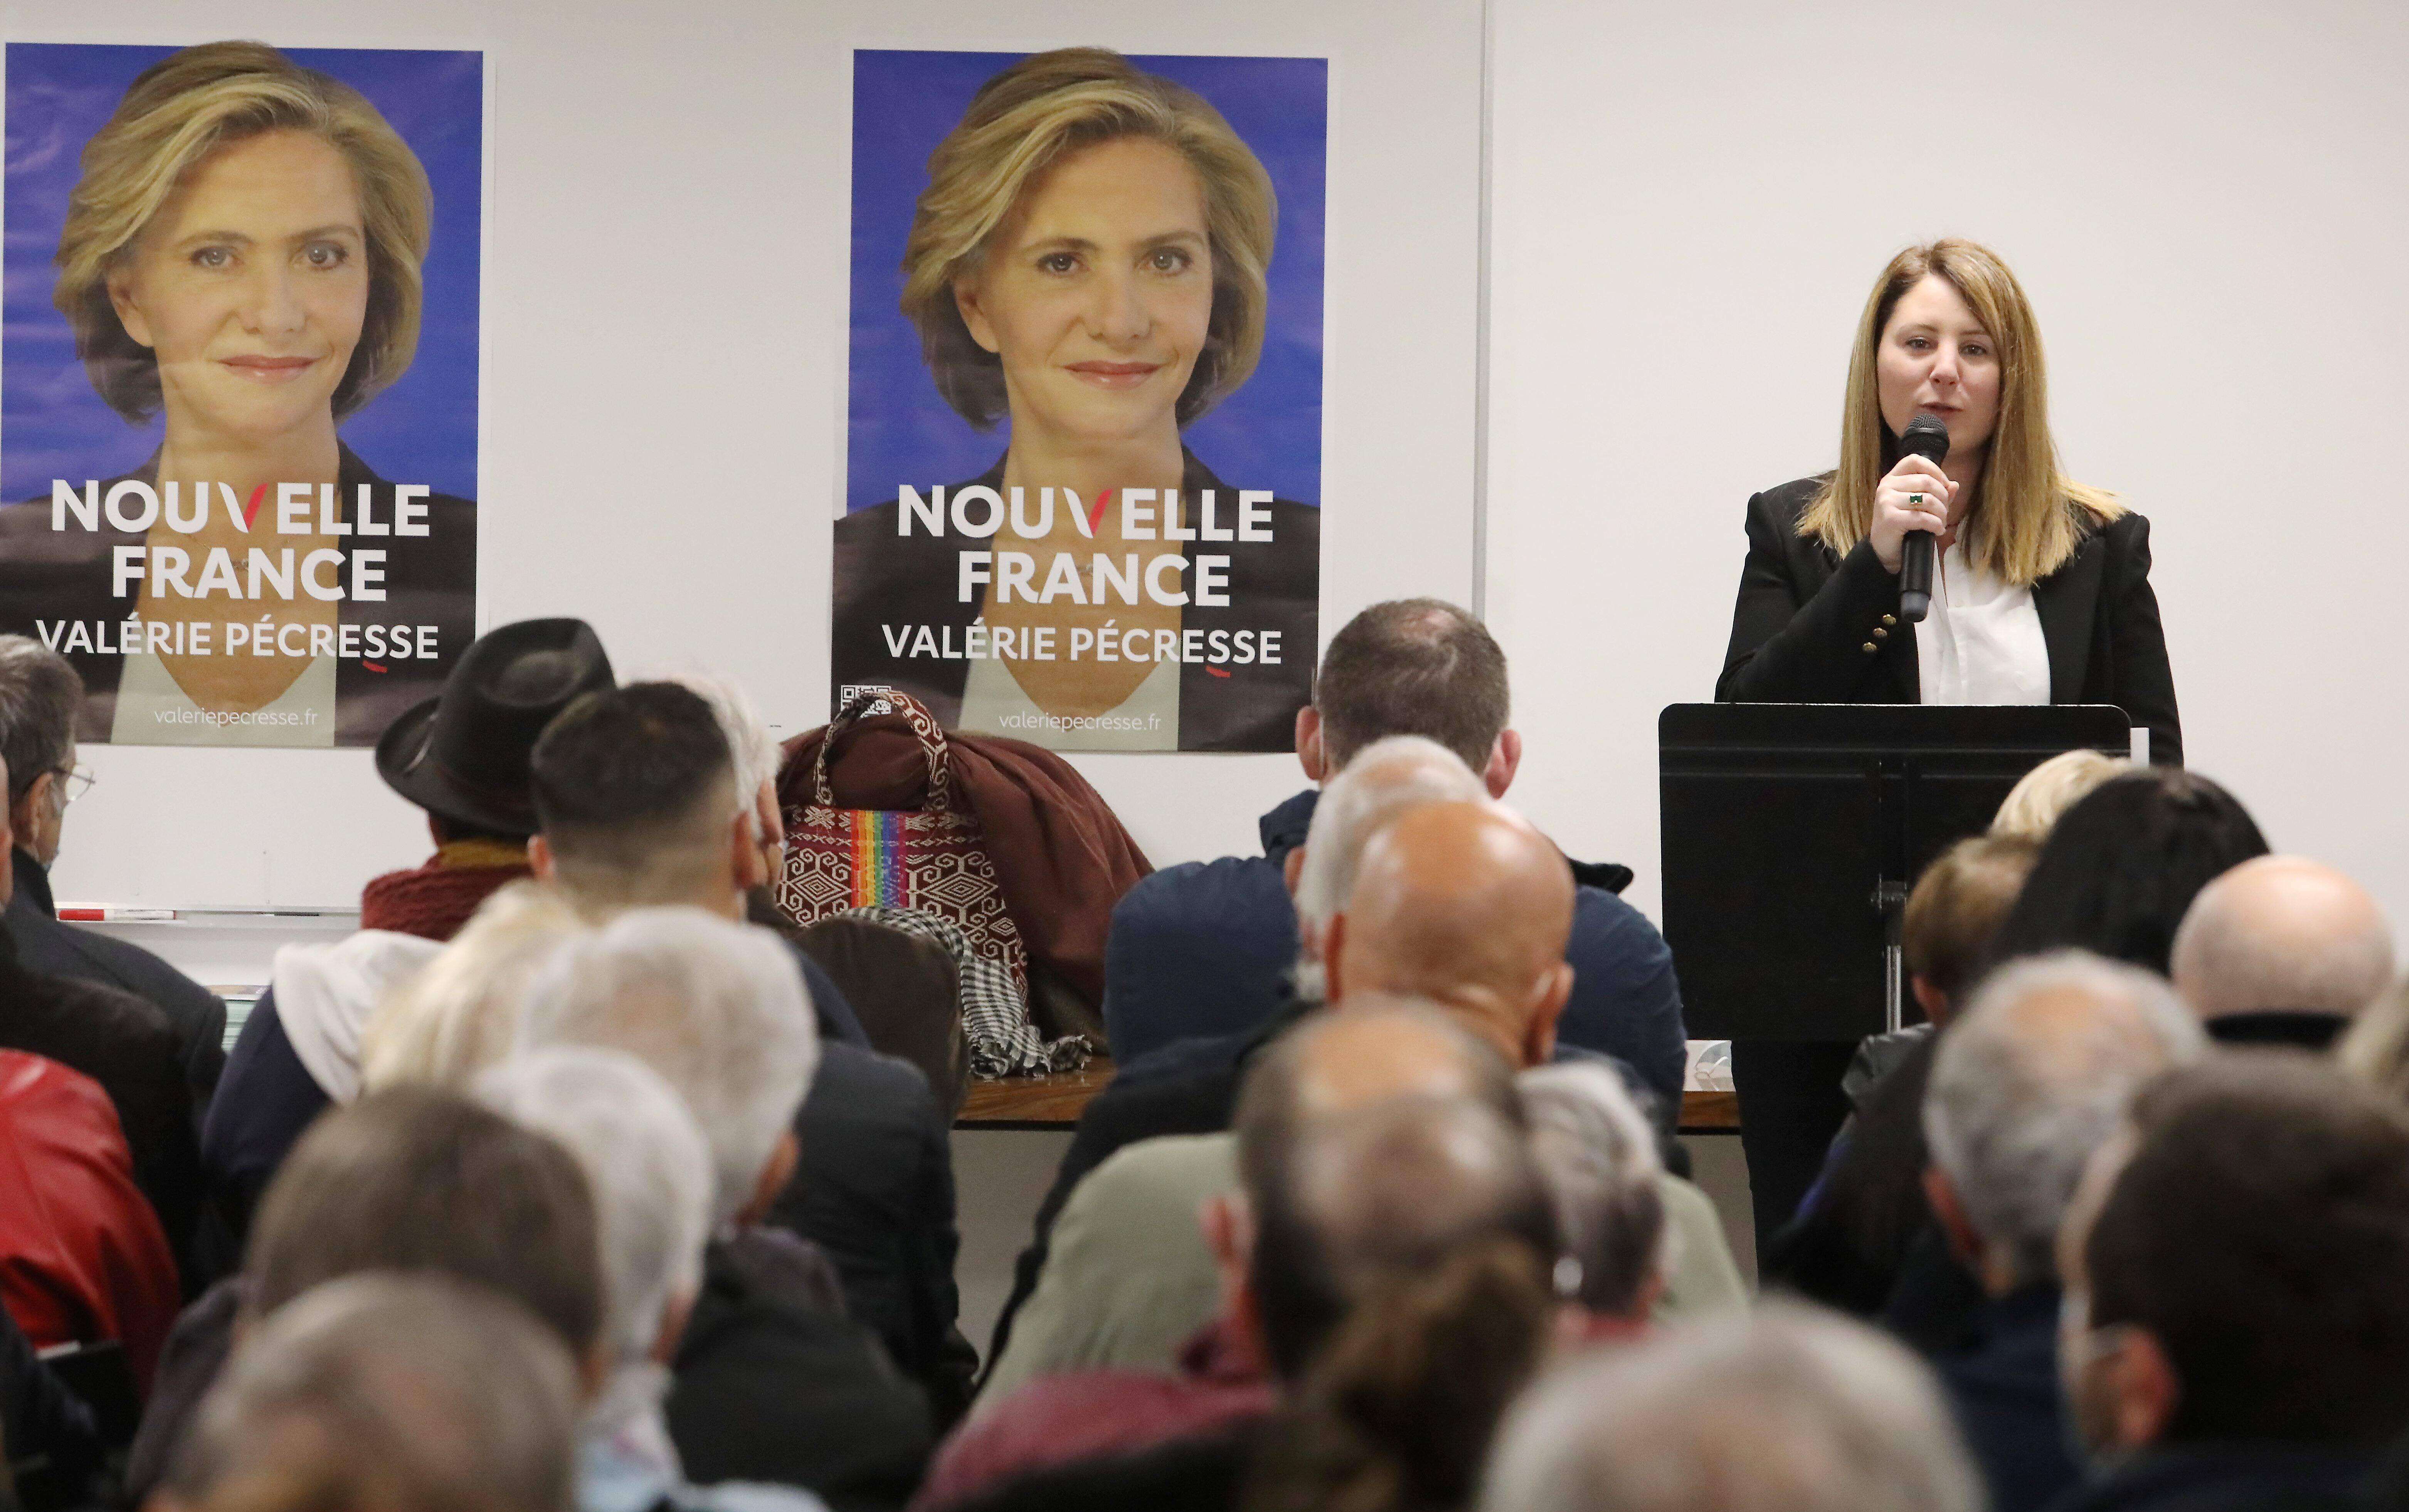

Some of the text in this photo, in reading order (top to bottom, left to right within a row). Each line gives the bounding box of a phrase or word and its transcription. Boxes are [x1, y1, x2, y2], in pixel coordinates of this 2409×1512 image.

[52, 479, 430, 536] NOUVELLE
[898, 484, 1273, 542] NOUVELLE
[113, 546, 387, 601] FRANCE
[958, 551, 1230, 607] FRANCE
[35, 611, 438, 659] VALÉRIE PÉCRESSE
[882, 616, 1282, 664] VALÉRIE PÉCRESSE
[154, 706, 318, 728] valeriepecresse.fr
[999, 711, 1161, 733] valeriepecresse.fr
